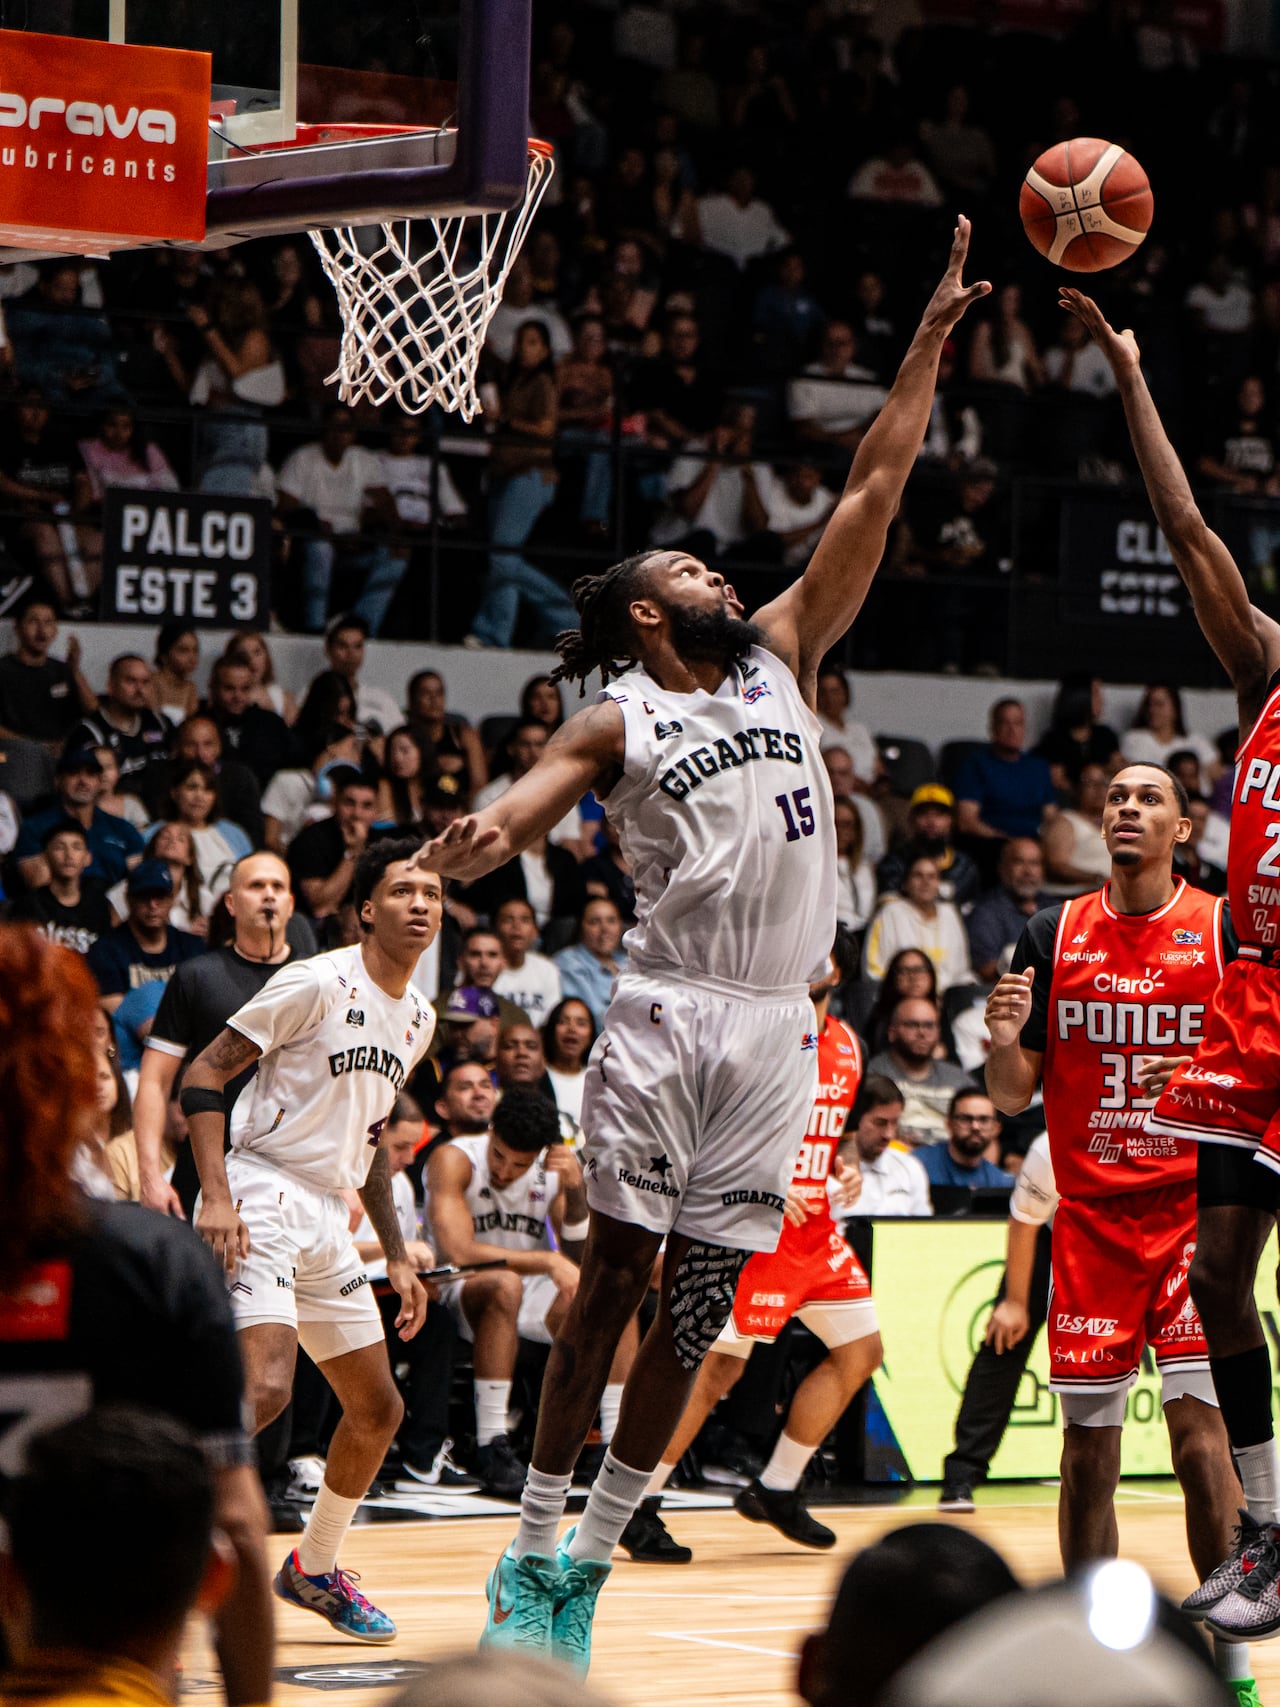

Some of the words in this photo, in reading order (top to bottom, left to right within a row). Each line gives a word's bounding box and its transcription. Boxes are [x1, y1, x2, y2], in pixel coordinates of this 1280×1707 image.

[122, 504, 255, 560] PALCO
[116, 564, 217, 619] ESTE
[229, 572, 258, 621] 3
[775, 786, 816, 842] 15
[1062, 950, 1108, 964] equiply
[1094, 973, 1154, 994] Claro
[1057, 999, 1206, 1045] PONCE
[328, 1045, 405, 1092] GIGANT
[1100, 1052, 1165, 1110] 35
[1088, 1111, 1147, 1129] SUNO
[1126, 1138, 1175, 1147] MASTER
[1126, 1147, 1178, 1158] MOTORS
[721, 1190, 785, 1214] GIGANTE
[340, 1274, 368, 1297] GIGAN
[1056, 1313, 1119, 1337] U-SAVE
[1161, 1322, 1203, 1337] LOTER
[1055, 1346, 1114, 1364] SALUS
